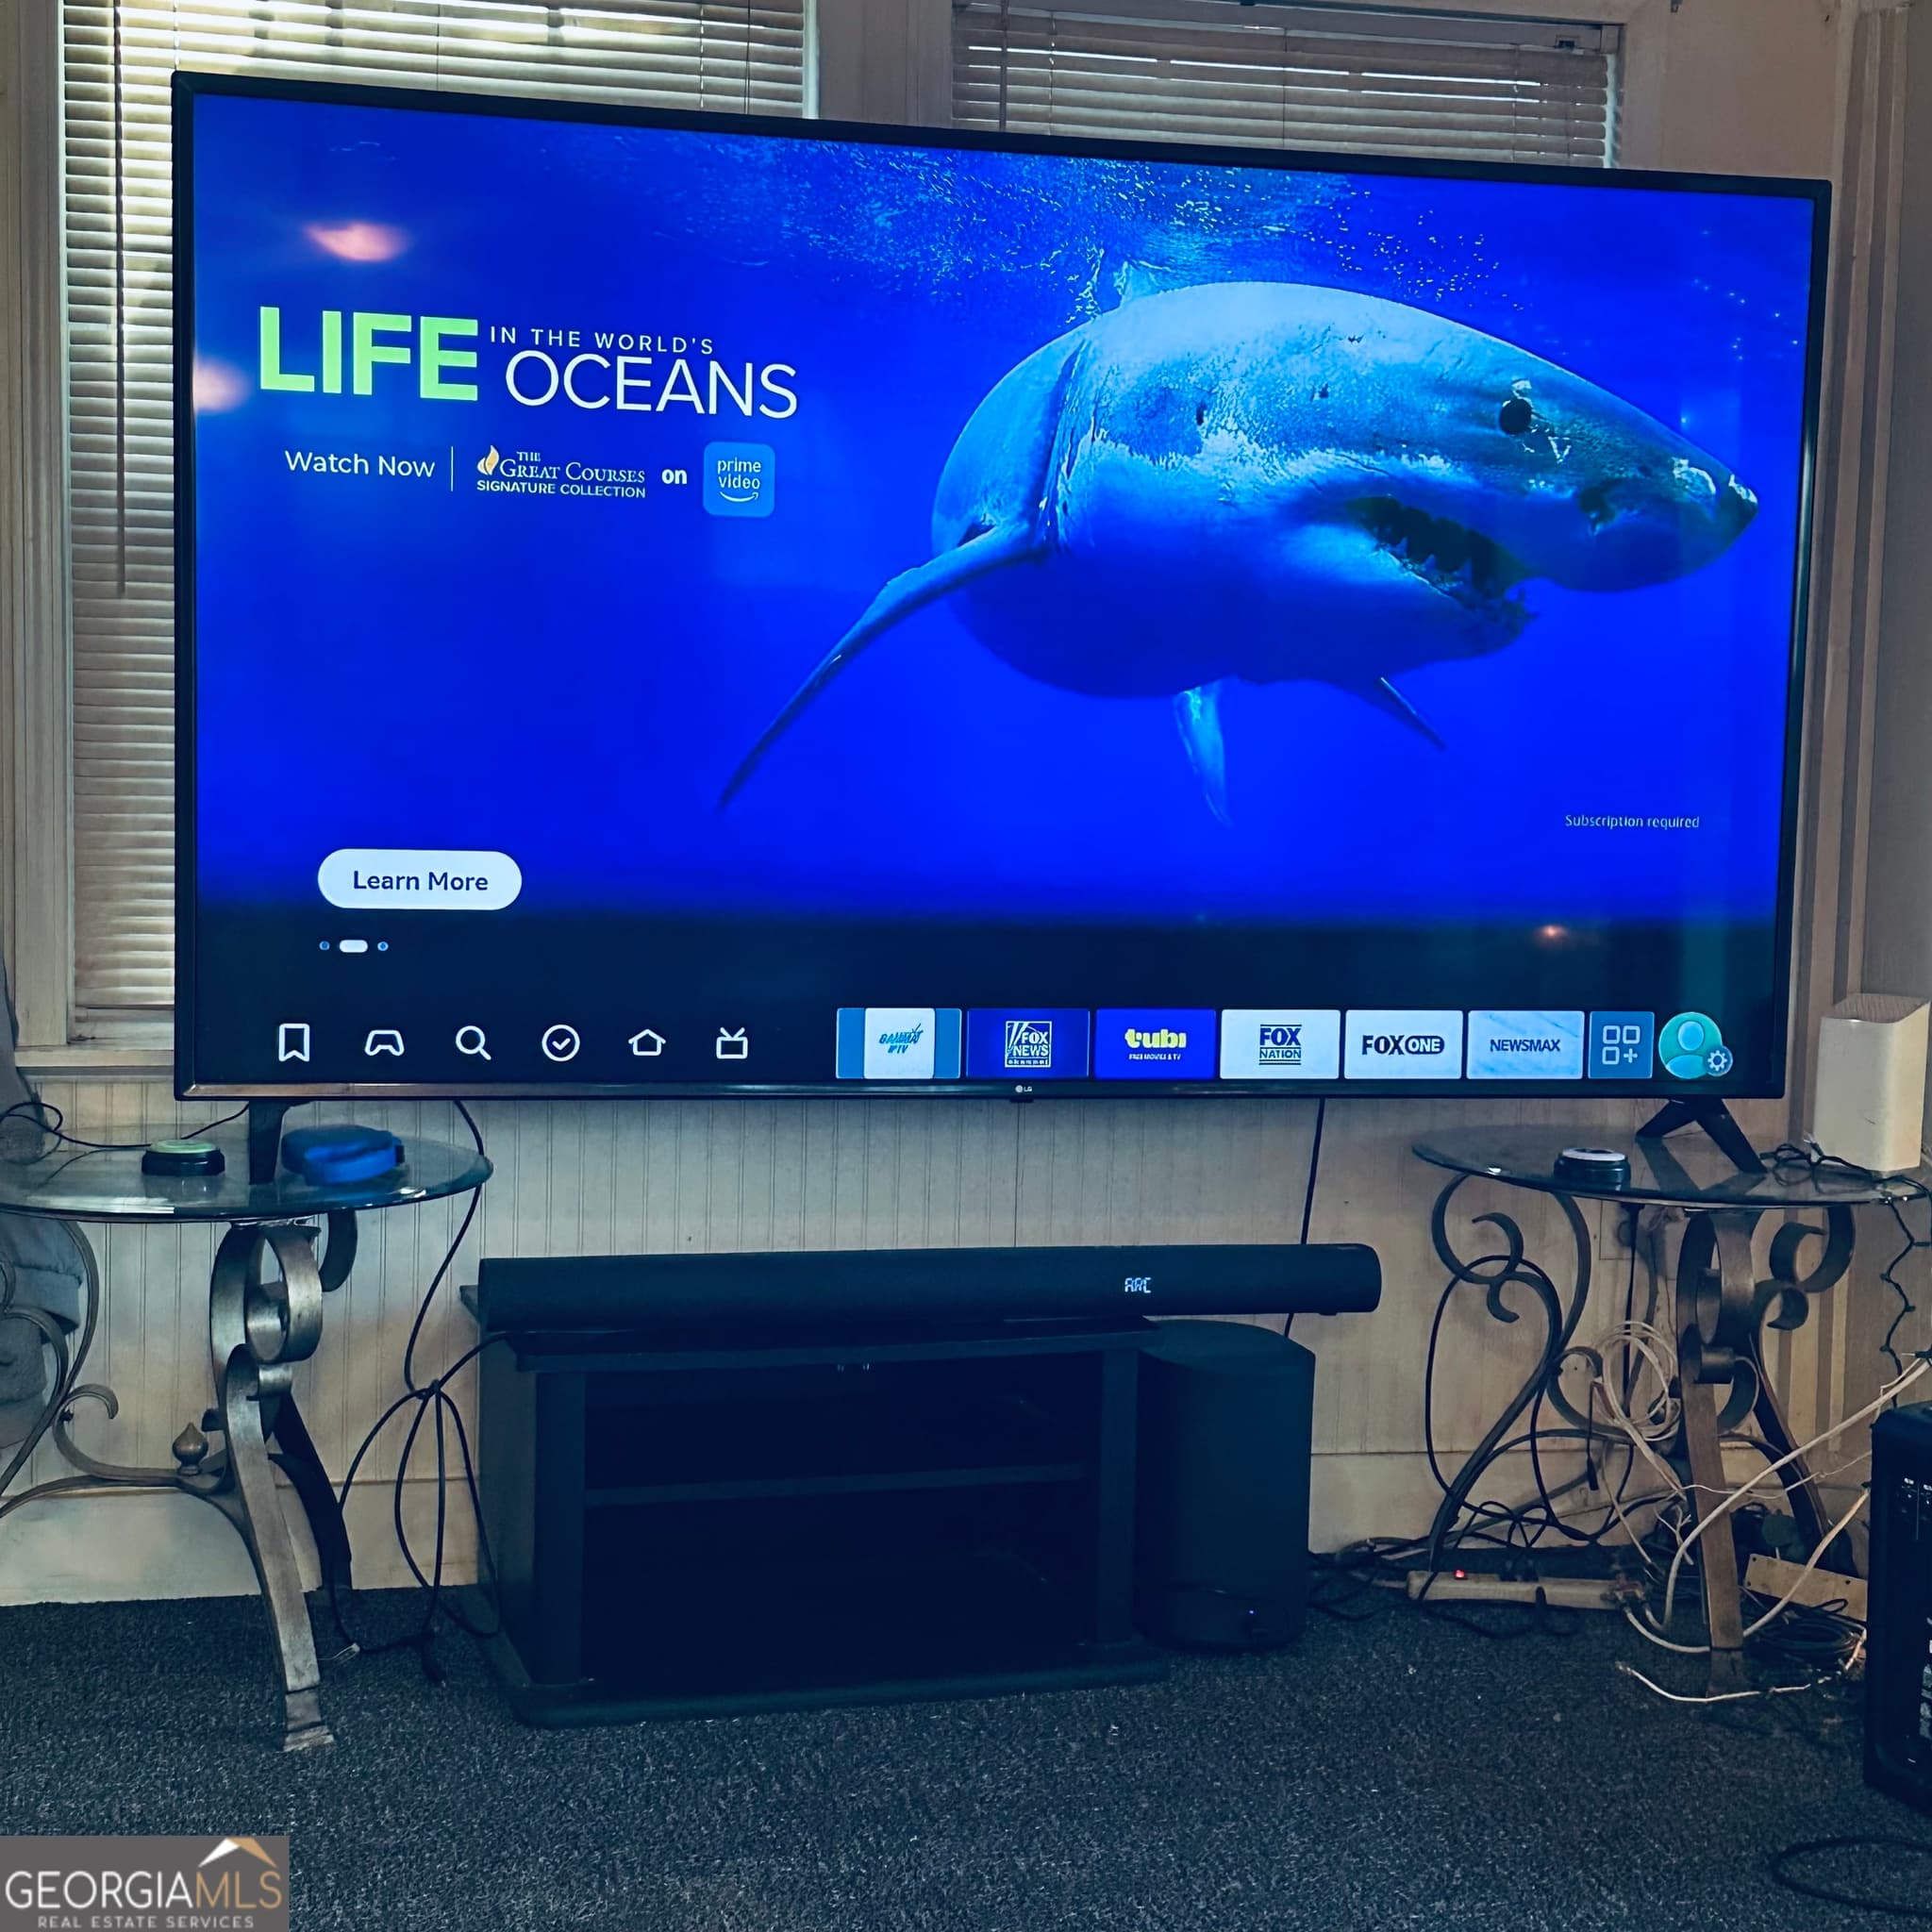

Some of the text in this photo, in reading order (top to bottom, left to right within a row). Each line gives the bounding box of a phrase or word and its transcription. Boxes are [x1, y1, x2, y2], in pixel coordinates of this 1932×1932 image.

[491, 325, 713, 355] IN THE WORLD'S
[259, 305, 478, 402] LIFE
[505, 349, 797, 419] OCEANS
[285, 450, 436, 477] Watch Now
[517, 451, 541, 461] THE
[717, 457, 761, 475] prime
[661, 469, 688, 485] on
[718, 475, 760, 490] video
[476, 479, 646, 499] SIGNATURE COLLECTION
[1565, 814, 1700, 830] Subscription required
[353, 870, 489, 891] Learn More
[1021, 1031, 1048, 1044] FOX
[1259, 1027, 1301, 1046] FOX
[1012, 1044, 1049, 1057] NEWS
[1259, 1047, 1301, 1059] NATION
[1490, 1039, 1560, 1052] NEWSMAX
